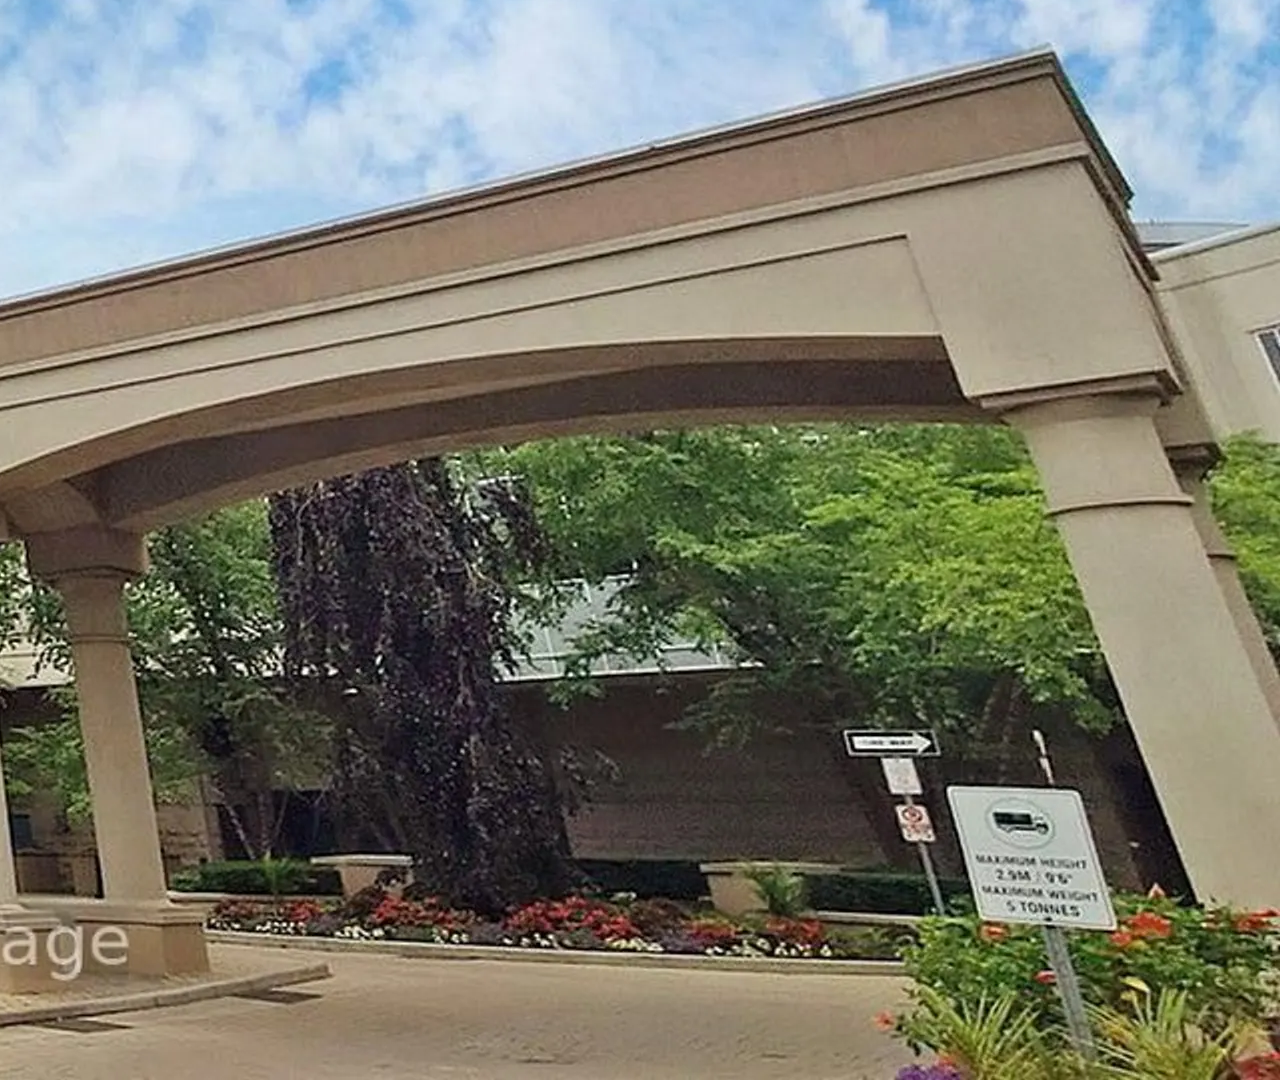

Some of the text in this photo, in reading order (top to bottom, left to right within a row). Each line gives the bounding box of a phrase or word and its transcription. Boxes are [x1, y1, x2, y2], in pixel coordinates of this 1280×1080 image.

[976, 854, 1086, 869] MAXIMUM HEIGHT
[982, 885, 1098, 902] MAXIMUM WEIGHT
[1006, 900, 1081, 917] 5 TONNES
